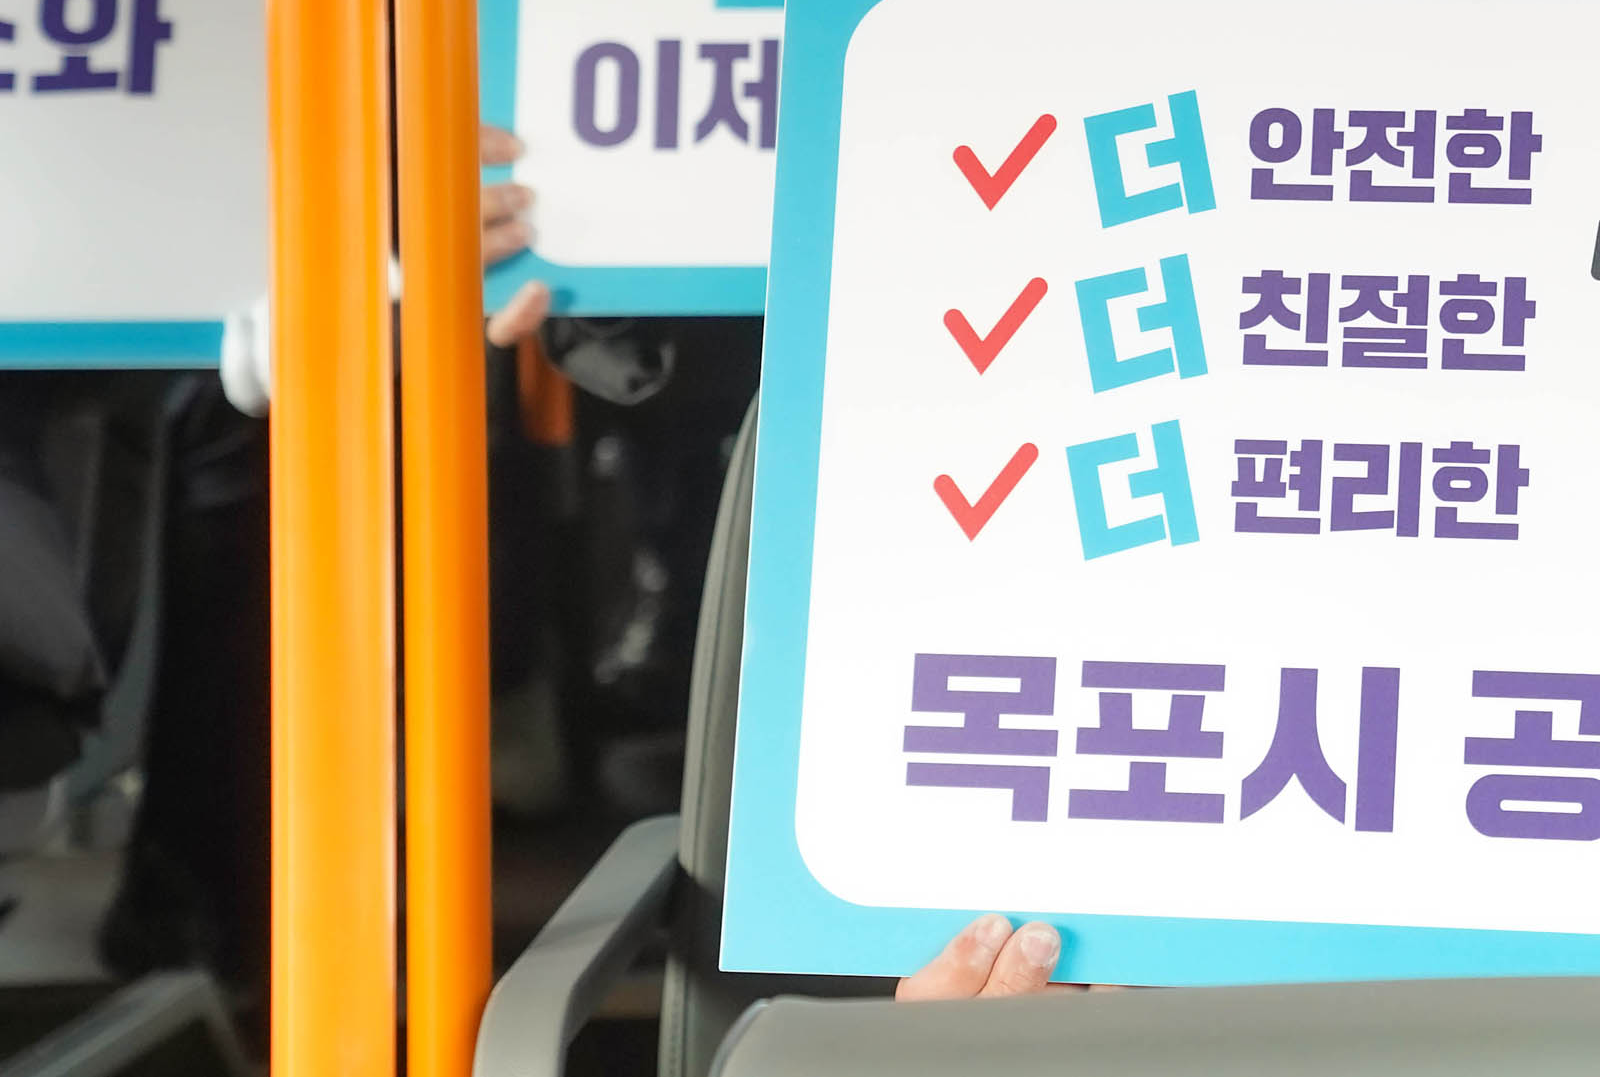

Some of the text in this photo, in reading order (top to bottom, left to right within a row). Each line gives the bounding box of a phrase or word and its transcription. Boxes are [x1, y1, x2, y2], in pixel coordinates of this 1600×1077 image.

[1083, 89, 1543, 229] 더 안전한
[1074, 253, 1537, 394] 더 친절한
[1065, 418, 1530, 561] 더 편리한
[903, 652, 1401, 833] 목포시
